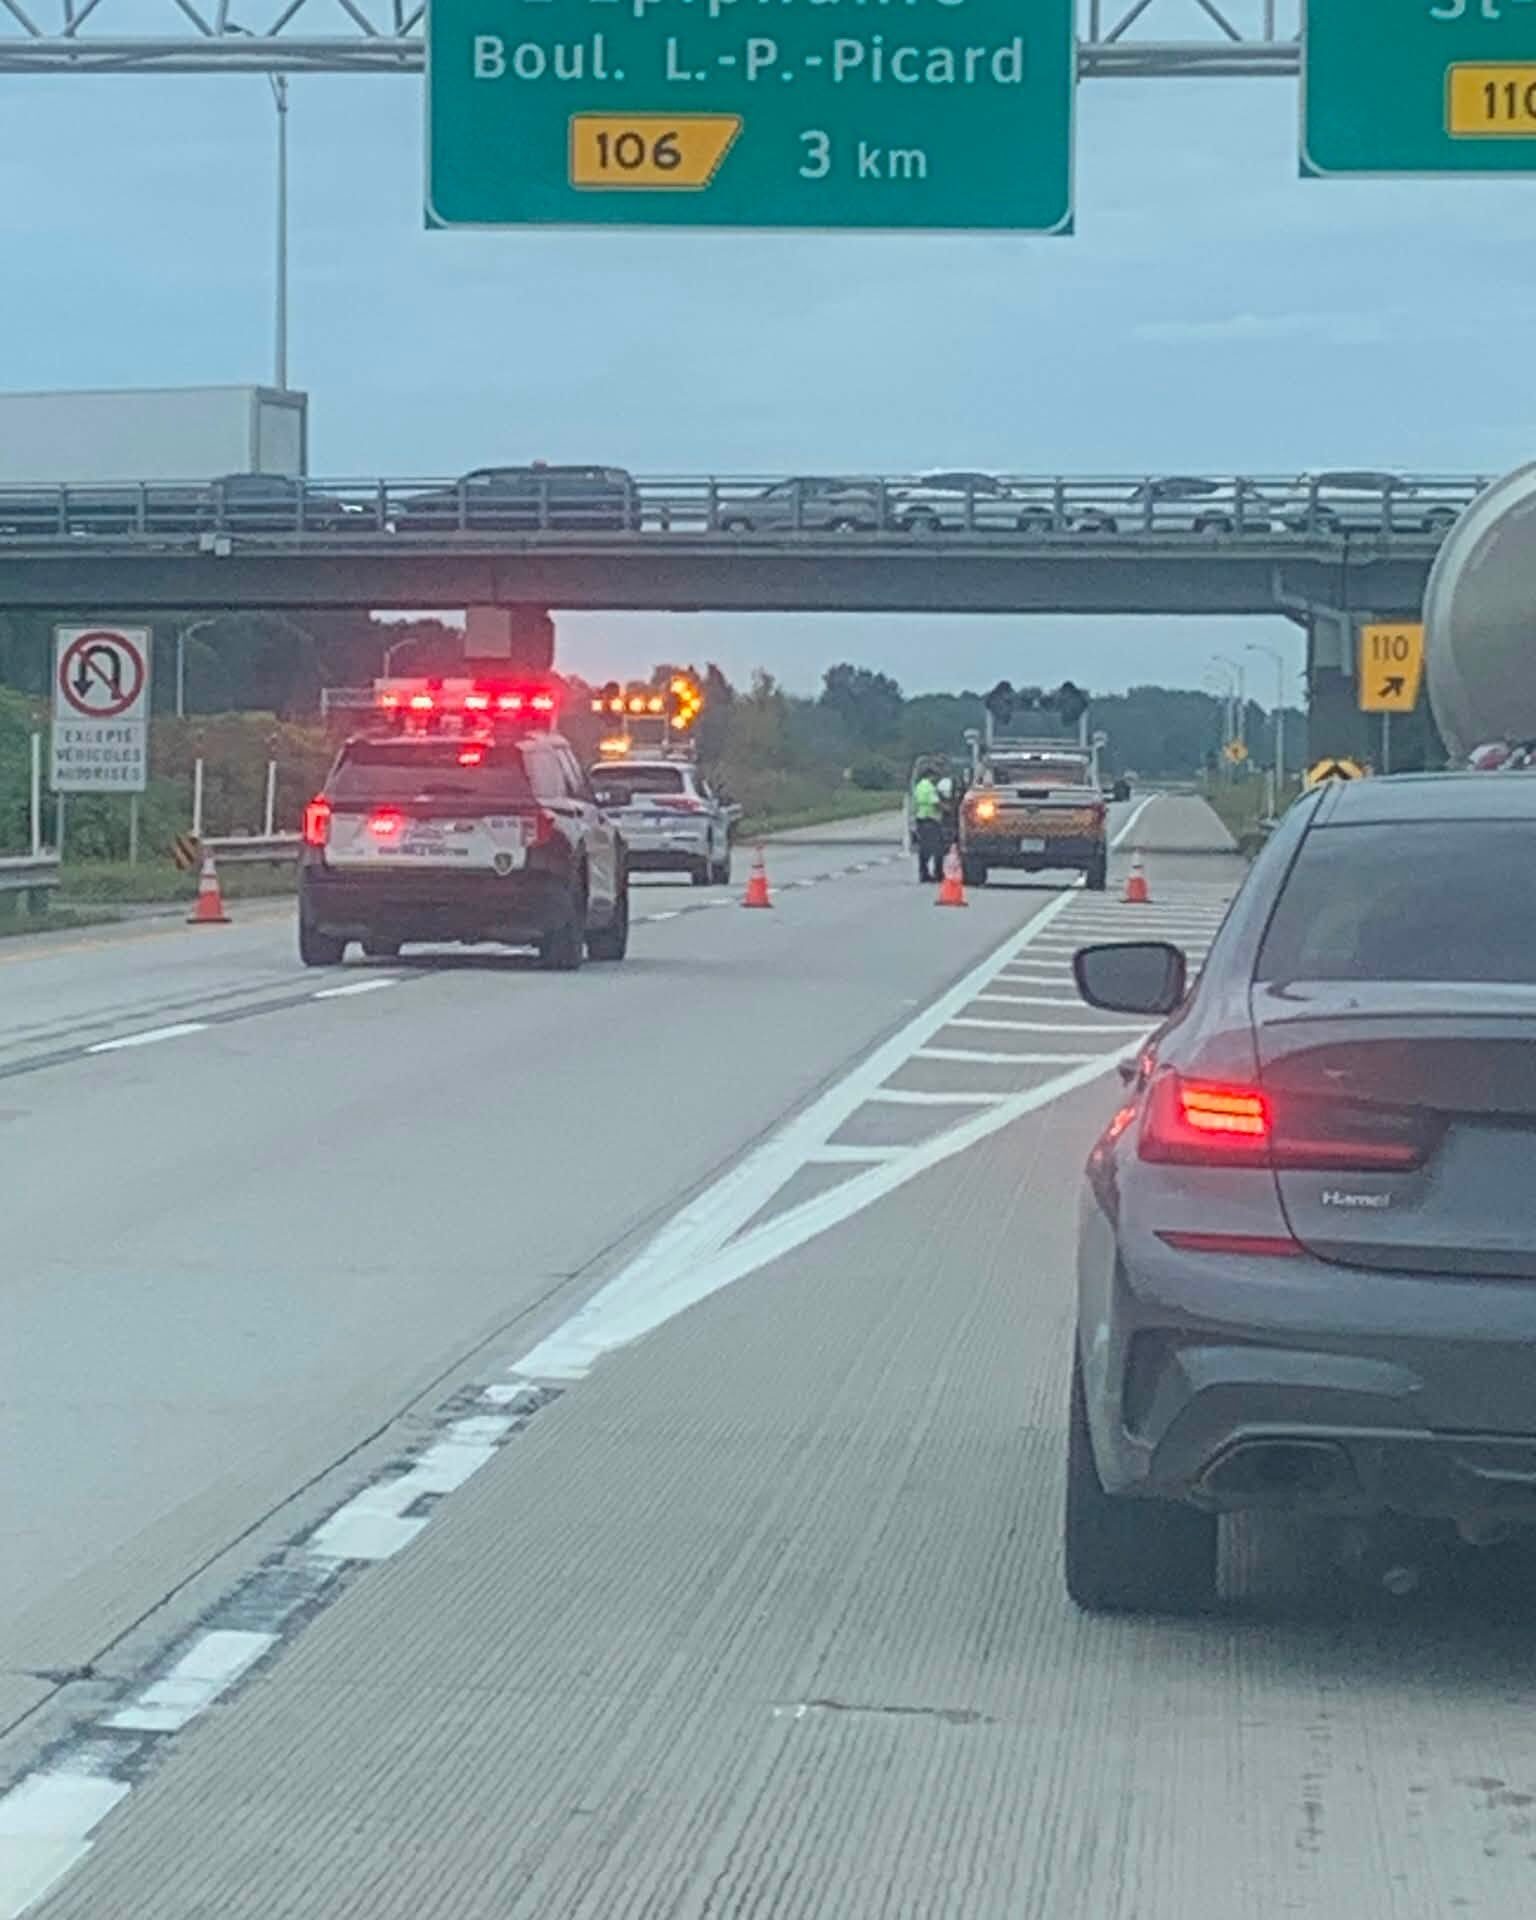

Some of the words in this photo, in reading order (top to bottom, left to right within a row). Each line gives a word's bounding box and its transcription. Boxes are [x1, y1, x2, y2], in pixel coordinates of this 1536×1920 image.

[473, 32, 625, 80] Boul.
[666, 35, 1024, 84] L.-P.-Picard
[595, 130, 683, 171] 106
[798, 129, 831, 179] 3
[857, 140, 928, 179] km
[1372, 634, 1410, 662] 110
